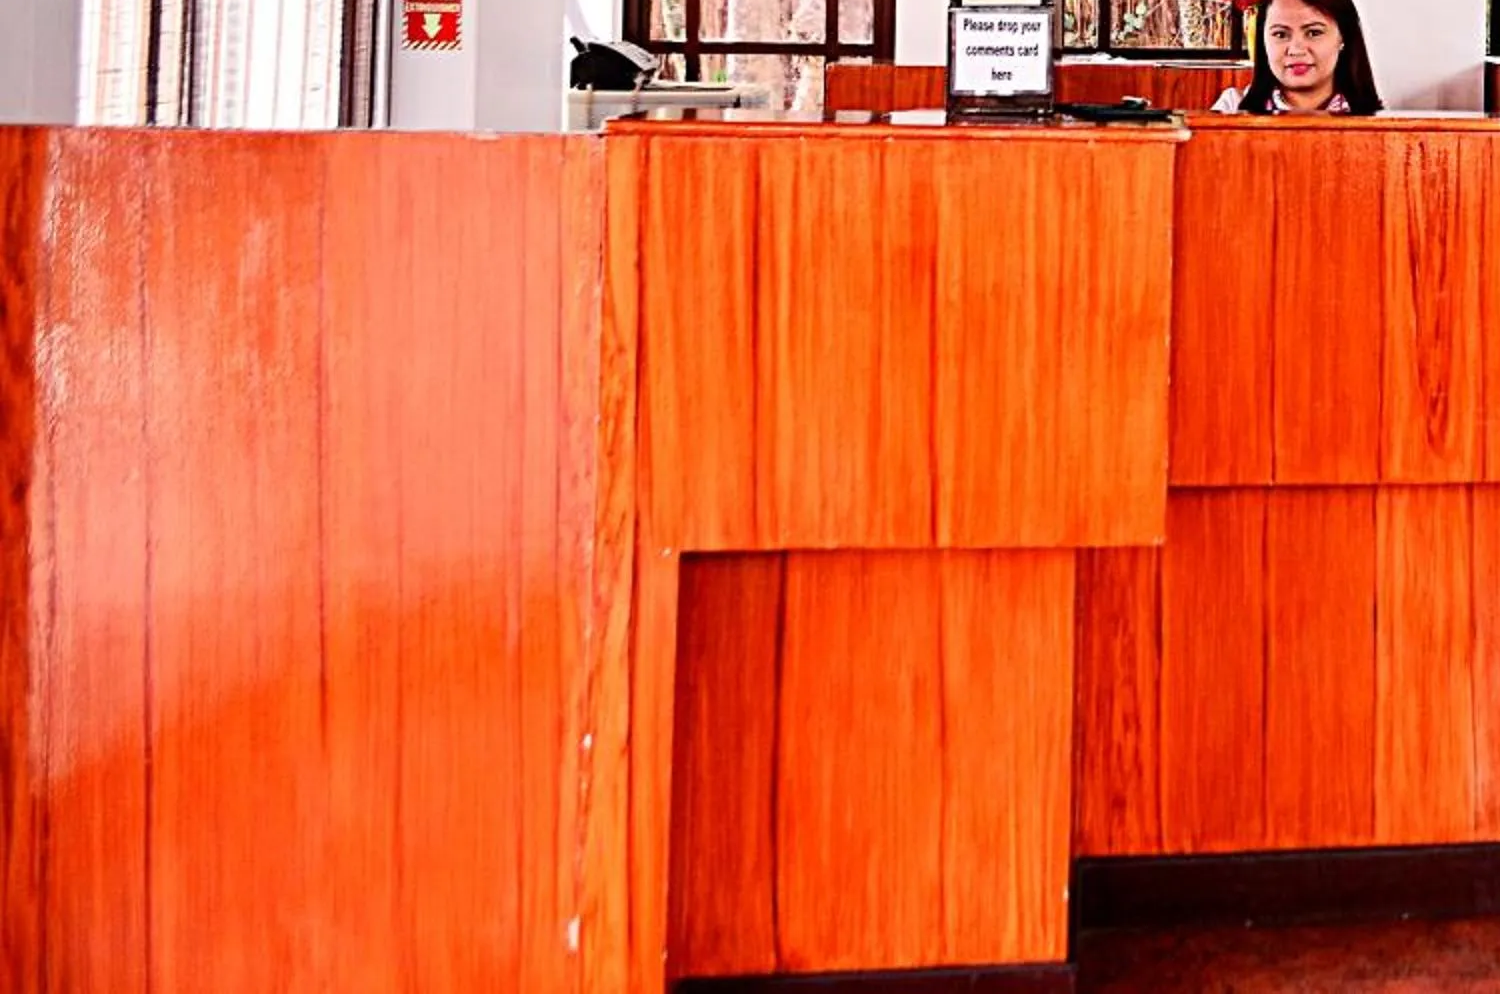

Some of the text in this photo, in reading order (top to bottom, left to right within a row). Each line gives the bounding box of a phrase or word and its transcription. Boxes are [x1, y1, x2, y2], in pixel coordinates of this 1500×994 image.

[963, 18, 1041, 35] Please drop your
[966, 43, 1039, 57] comments card
[991, 67, 1012, 81] here
